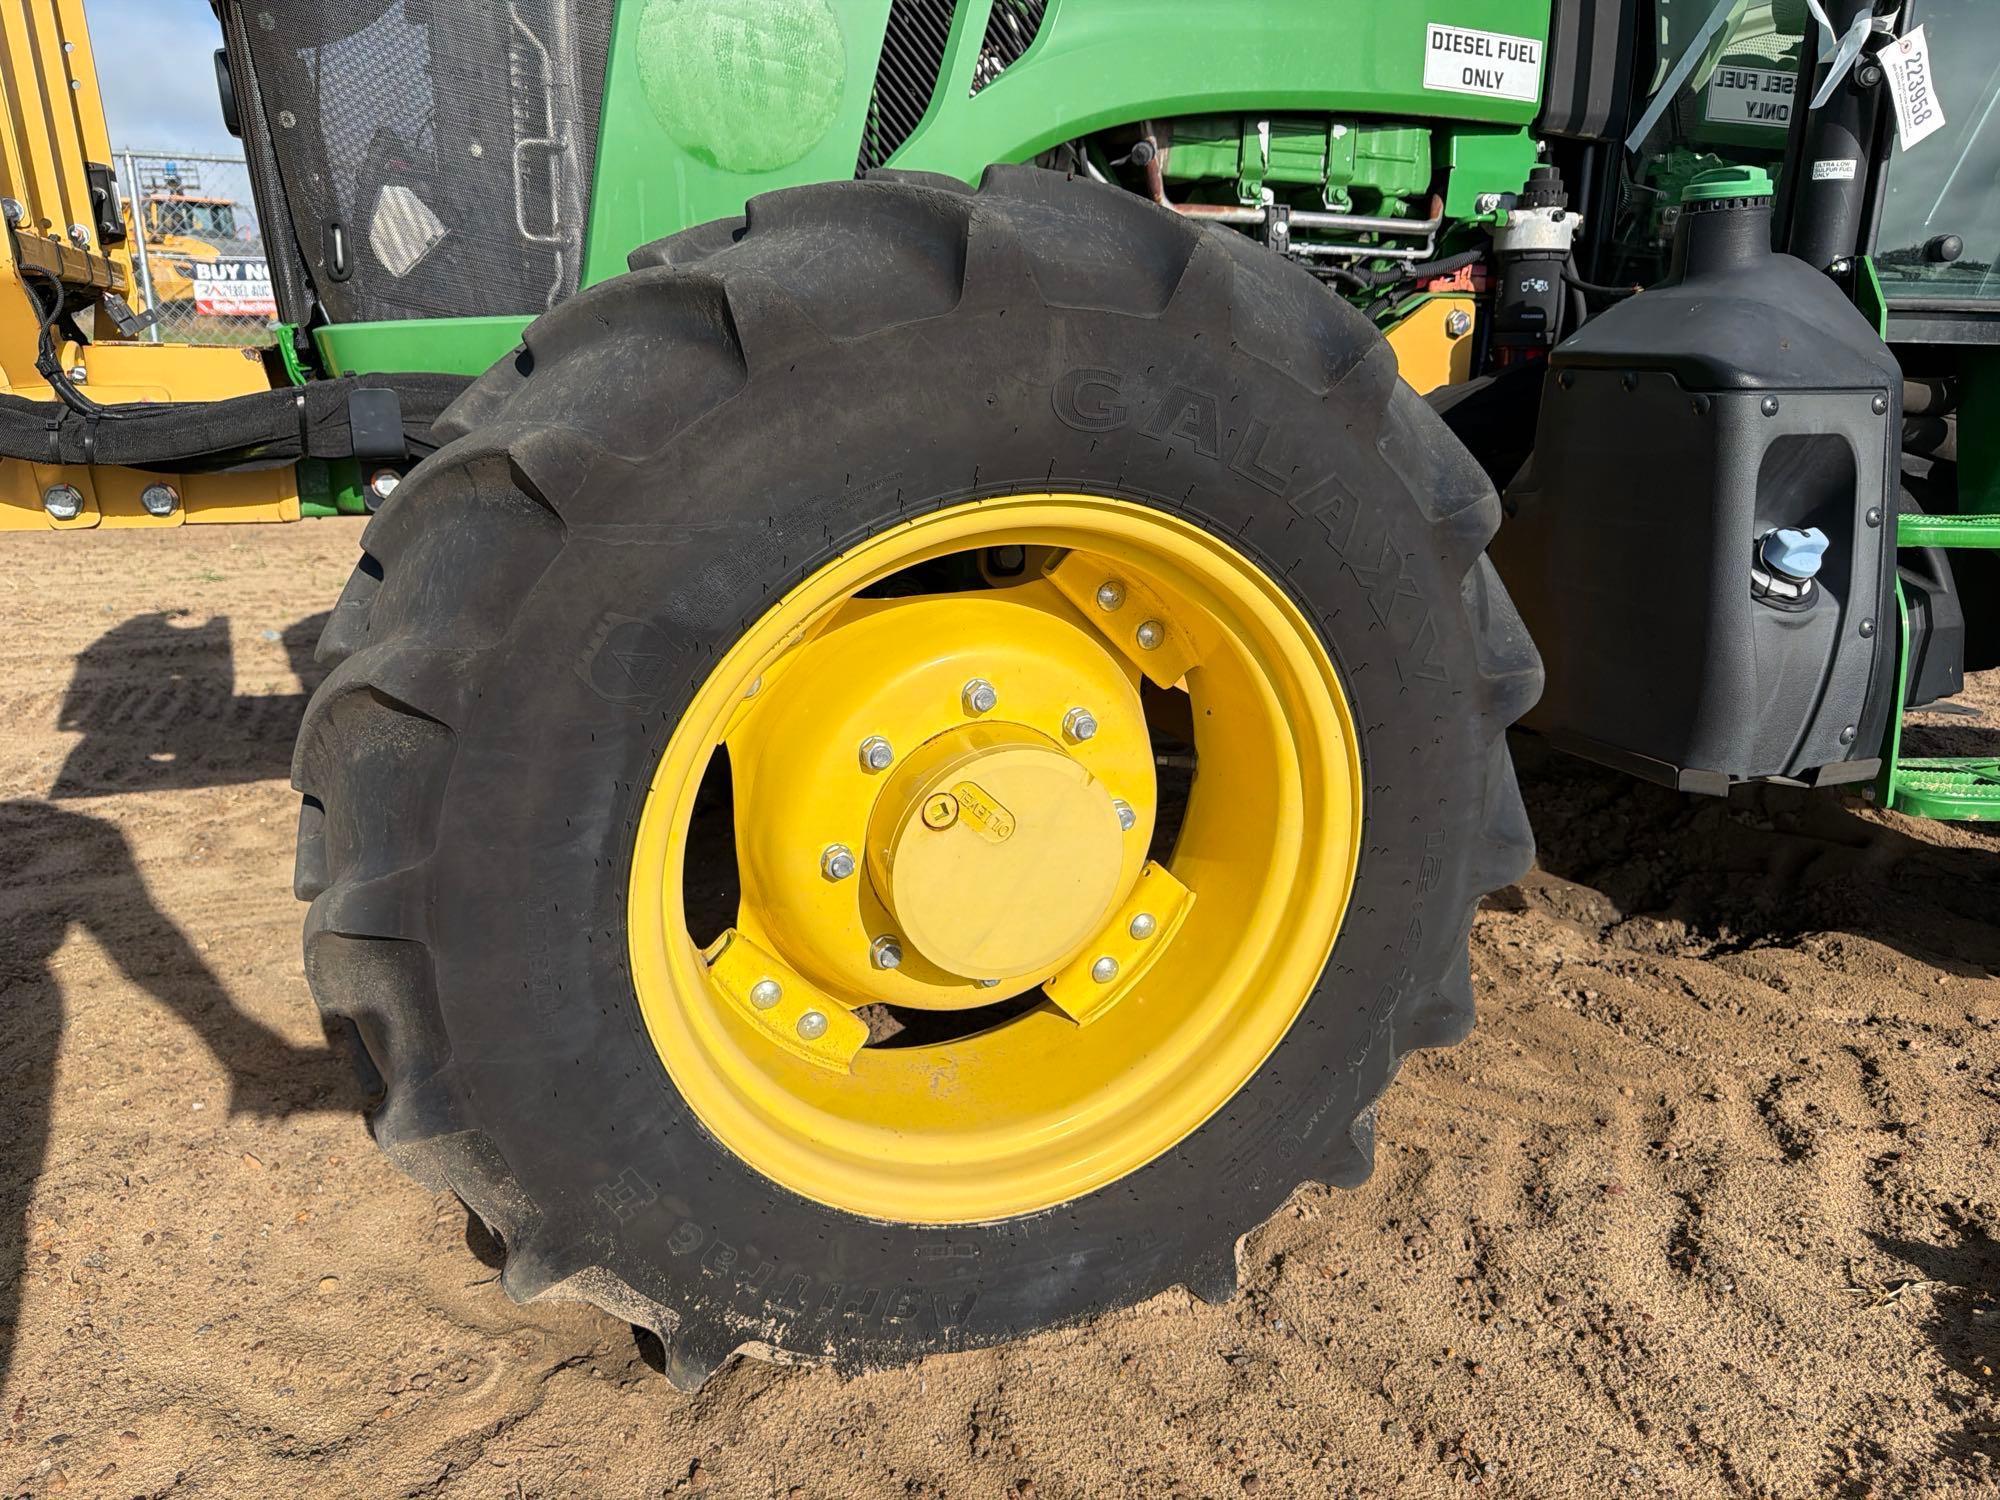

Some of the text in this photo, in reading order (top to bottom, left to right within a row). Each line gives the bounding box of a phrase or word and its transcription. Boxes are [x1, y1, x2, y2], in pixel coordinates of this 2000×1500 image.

[1432, 31, 1536, 64] DIESEL FUEL
[1462, 67, 1504, 89] ONLY
[1905, 52, 1932, 125] 223958
[196, 263, 240, 280] BUY
[1051, 369, 1449, 684] GALAXY
[958, 789, 1010, 837] OIL LEVEL
